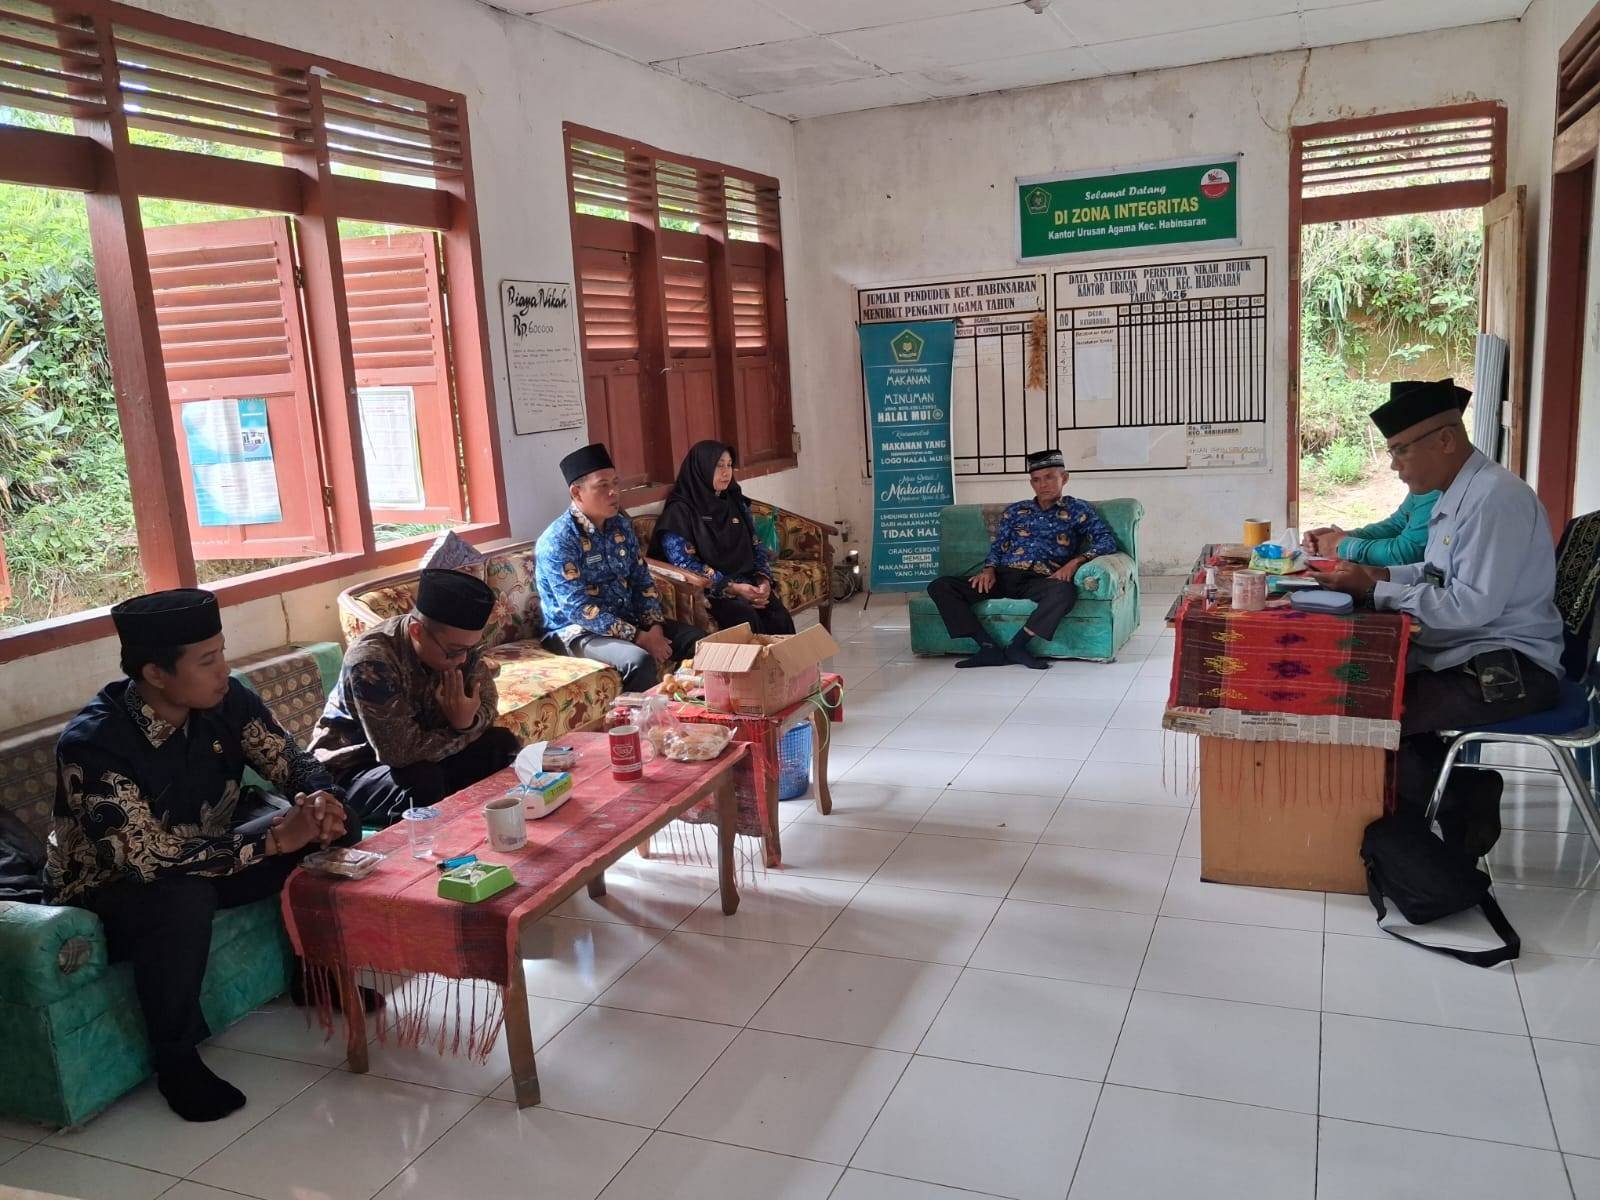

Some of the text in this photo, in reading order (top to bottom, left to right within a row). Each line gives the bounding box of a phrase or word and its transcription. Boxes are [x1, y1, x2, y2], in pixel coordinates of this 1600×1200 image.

[1084, 185, 1167, 201] Selamat Datang
[1054, 196, 1200, 226] DI ZONA INTEGRITAS
[1048, 217, 1207, 241] Kantor Urusan Agama Kec. Habinsaran
[1068, 260, 1252, 286] DATA STATISTIK PERISTIWA NIKAH RUJUK
[1077, 271, 1241, 297] KANTOR URUSAN AGAMA KEC. HABINSARAN
[866, 280, 1037, 307] JUMLAH PENDUDUK KEC. HABINSARAN
[1129, 291, 1157, 303] TAHUN
[507, 285, 569, 317] Biaya Nikah
[862, 297, 1016, 321] MENURUT PENGANUT AGAMA TAHUN
[886, 374, 931, 387] MAKANAN
[884, 392, 935, 405] MINUMAN
[877, 410, 931, 423] HALAL MUI
[881, 439, 947, 451] MAKANAN YANG
[880, 455, 943, 465] LOGO HALAL MUI
[880, 481, 945, 502] Makanlah
[879, 513, 909, 521] LINDUNGI
[882, 527, 939, 539] TIDAK HAL
[888, 547, 914, 555] ORANG
[903, 555, 931, 563] MEMILIH
[878, 563, 914, 571] MAKANAN
[919, 562, 939, 570] MINU
[914, 569, 938, 577] HALAL
